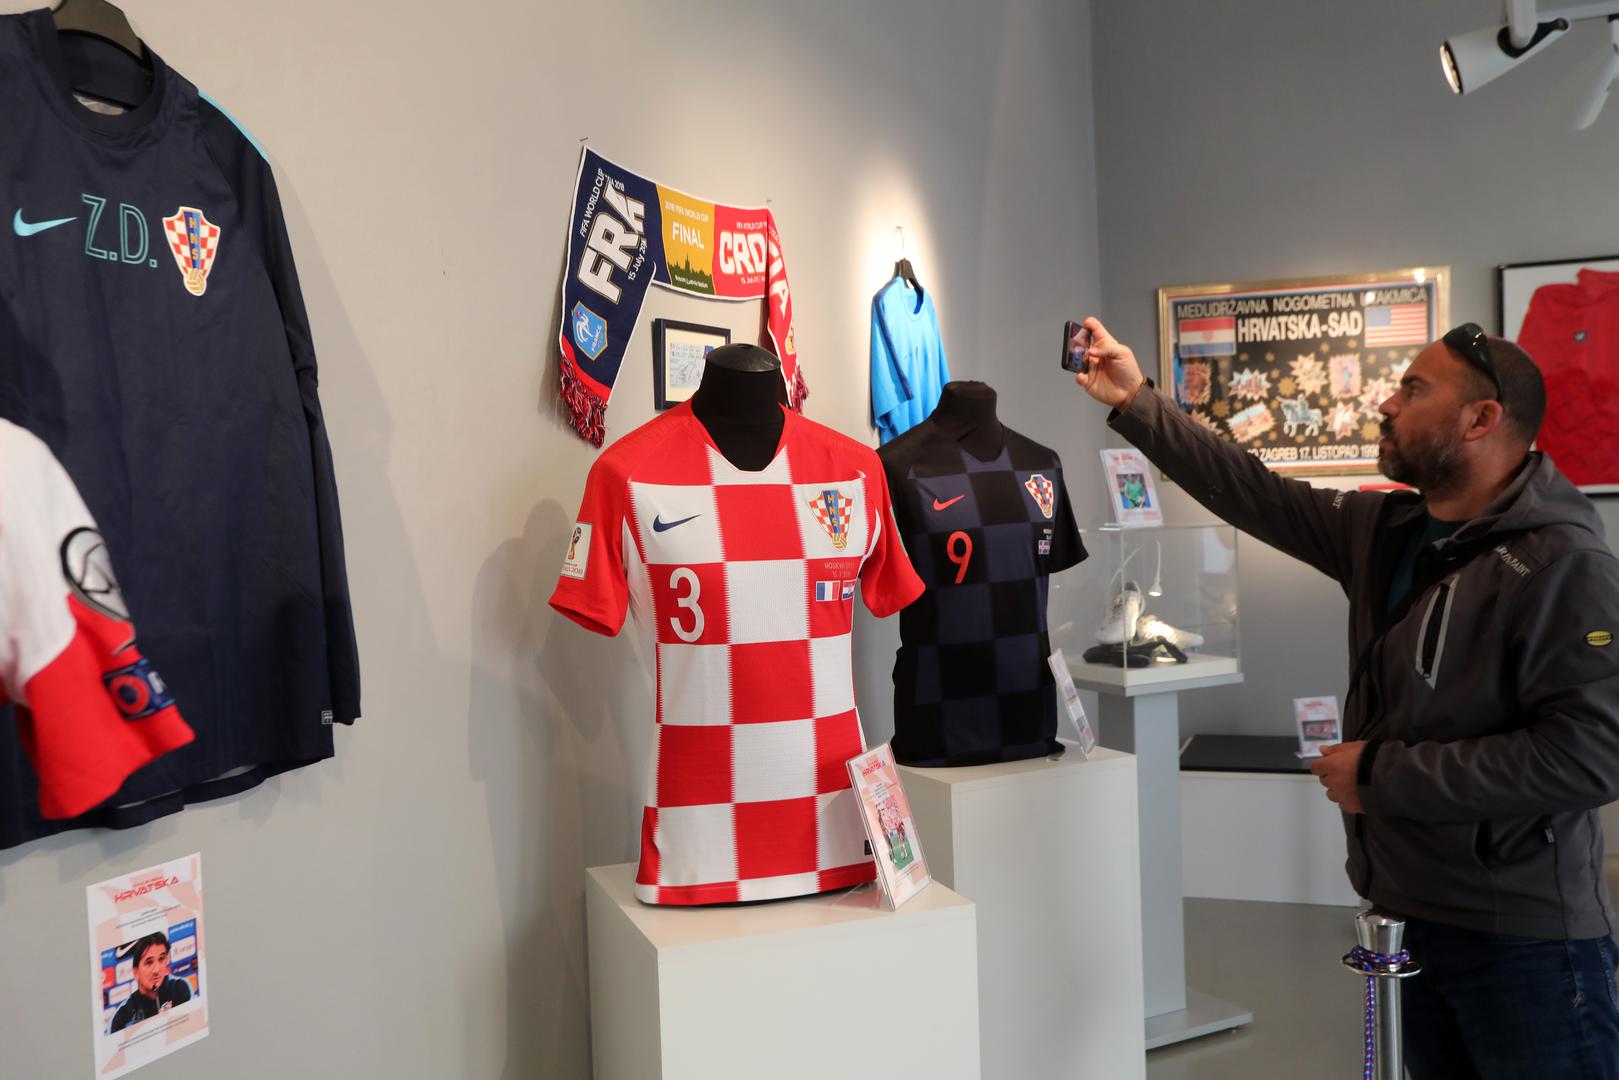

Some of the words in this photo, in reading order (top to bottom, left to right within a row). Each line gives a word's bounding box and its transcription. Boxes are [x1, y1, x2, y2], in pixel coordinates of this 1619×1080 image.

[595, 168, 605, 188] CUP
[584, 186, 600, 222] WORLD
[81, 193, 158, 268] Z.D.
[580, 219, 591, 237] FIFA
[672, 221, 705, 249] FINAL
[628, 270, 636, 281] 15
[635, 253, 645, 271] July
[1273, 292, 1356, 312] NOGOMETNA
[1237, 311, 1363, 342] HRVATSKA-SAD
[1259, 447, 1298, 461] ZAGREB
[1312, 444, 1359, 459] LISTOPAD
[827, 494, 839, 527] HNS
[946, 530, 973, 585] 9
[669, 567, 705, 643] 3
[114, 876, 180, 903] HRVATSKA
